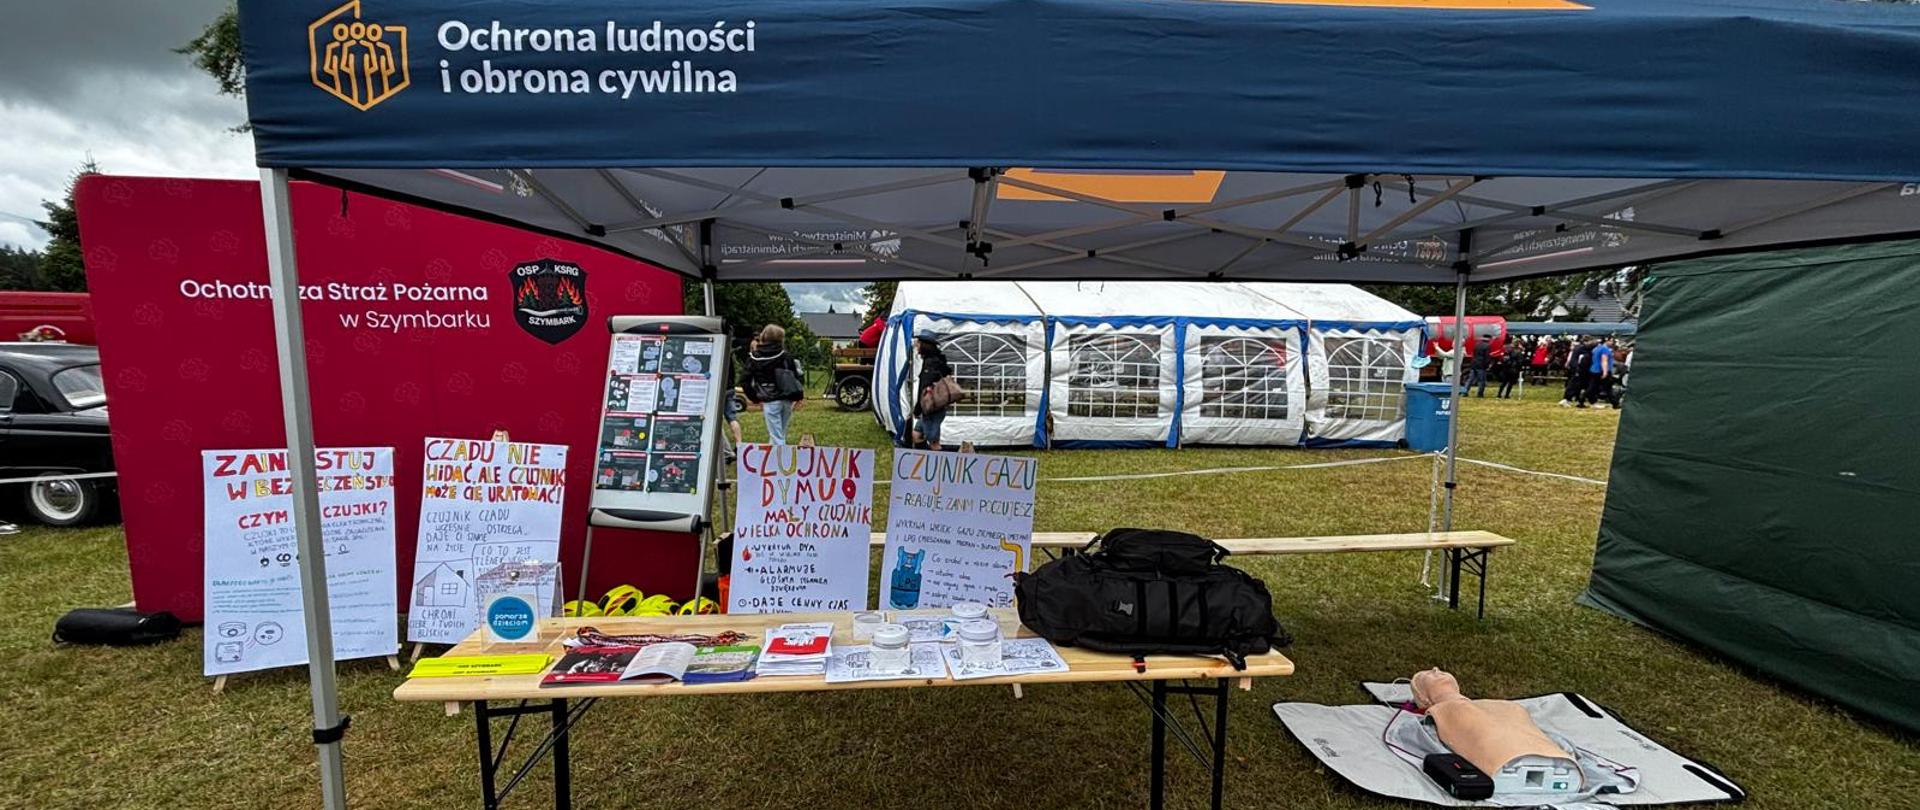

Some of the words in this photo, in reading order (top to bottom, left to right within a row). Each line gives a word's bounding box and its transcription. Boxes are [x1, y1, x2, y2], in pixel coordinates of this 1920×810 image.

[437, 20, 597, 52] Ochrona
[607, 20, 756, 52] ludności
[440, 59, 452, 93] i
[460, 60, 591, 93] obrona
[598, 60, 737, 99] cywilna
[517, 265, 539, 277] OSP
[554, 265, 579, 277] KSRG
[180, 279, 323, 301] Ochotnza
[328, 281, 388, 302] Straż
[394, 282, 488, 302] Pożarna
[339, 313, 359, 328] w
[366, 310, 491, 333] Szymbarku
[528, 316, 577, 327] SZYMBARK
[427, 440, 495, 463] CZADU
[508, 443, 541, 465] NIE
[742, 444, 862, 478] CZUJNIK
[478, 466, 501, 484] ALE
[509, 466, 567, 487] CZUJNIK
[897, 452, 978, 496] CZUJNIK
[984, 457, 1037, 490] GAZU
[227, 481, 248, 501] W
[426, 484, 456, 499] MOŻE
[488, 484, 561, 504] URATOWAĆ!
[762, 478, 836, 507] DYMU
[238, 510, 288, 529] CZYM
[323, 501, 388, 518] CZUJKI?
[478, 508, 510, 522] CZADU
[765, 505, 810, 524] MAŁY
[426, 532, 449, 543] DAJE
[786, 521, 849, 538] OCHRONA
[427, 544, 438, 552] NA
[760, 564, 816, 575] ALARMUJE
[753, 597, 783, 607] DAJE
[792, 597, 823, 609] CENNY
[828, 600, 849, 610] CZAS
